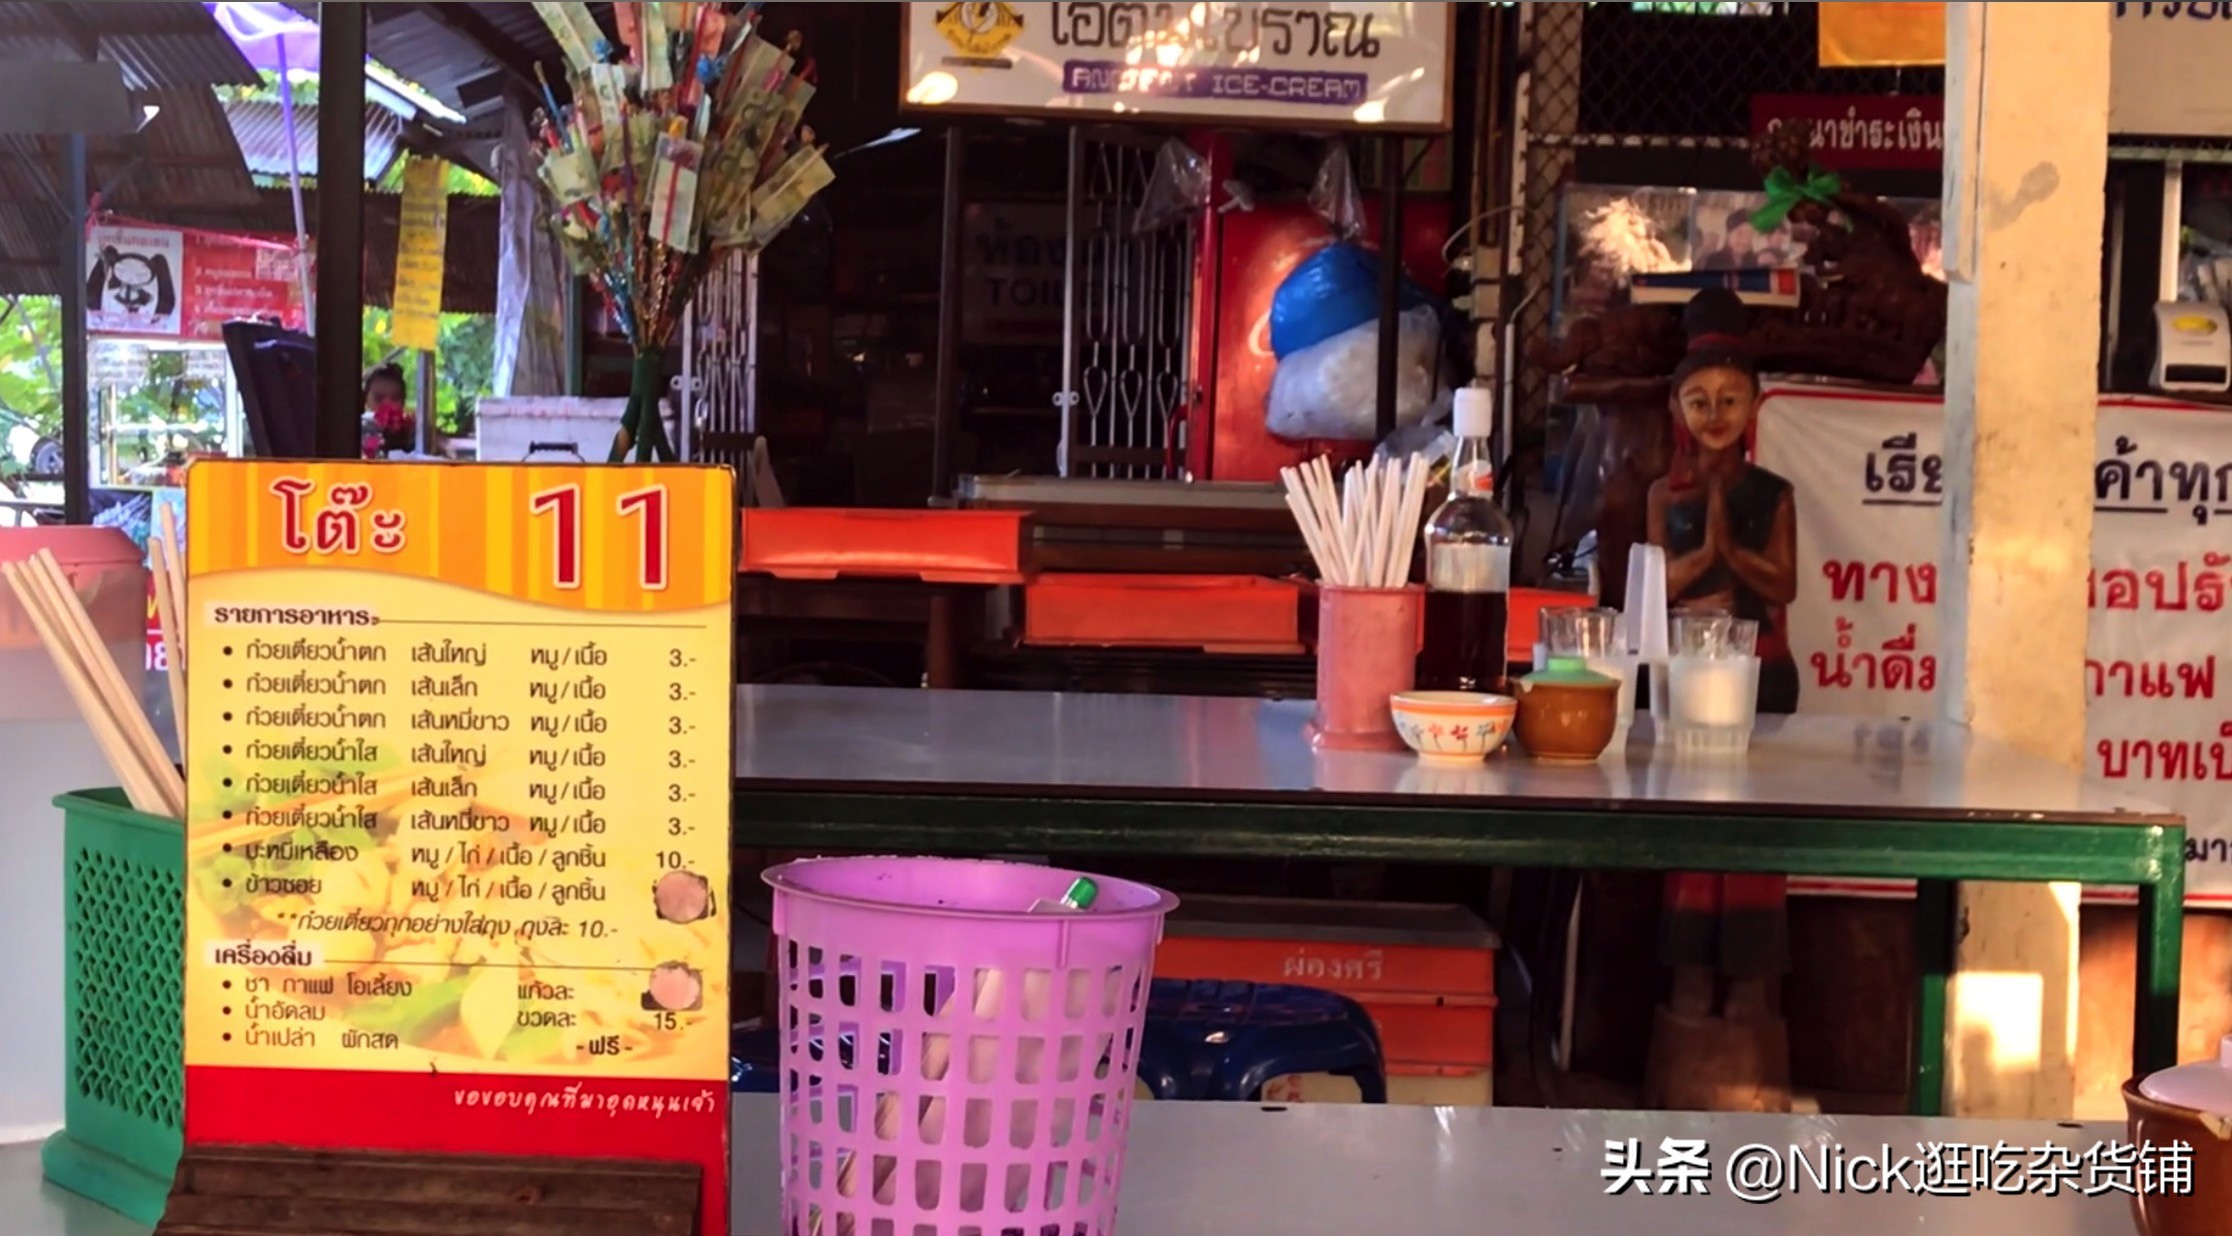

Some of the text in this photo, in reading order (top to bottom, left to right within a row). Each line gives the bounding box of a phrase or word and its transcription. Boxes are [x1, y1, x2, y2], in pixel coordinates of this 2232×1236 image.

[1212, 72, 1362, 98] ICE-CREAM
[271, 476, 669, 591] โต๊ะ 11
[2087, 551, 2232, 613] อปรั
[411, 638, 487, 667] เส้นใหญ่
[668, 648, 697, 668] 3.-
[411, 674, 478, 697] เส้นเล็ก
[668, 681, 697, 702] 3.-
[411, 706, 510, 732] เส้นหมี่ขาว
[668, 715, 697, 736] 3.-
[411, 739, 487, 768] เส้นใหญ่
[668, 749, 697, 769] 3.-
[411, 775, 478, 798] เส้นเล็ก
[668, 783, 697, 803] 3.-
[411, 806, 510, 832] เส้นหมี่ขาว
[668, 817, 697, 836] 3.-
[246, 873, 322, 894] ข้าวซอย
[579, 920, 619, 939] 10.-
[215, 940, 312, 966] เครื่องดื่ม
[246, 977, 270, 992] ชา
[282, 977, 334, 995] กาแฟ
[347, 972, 412, 997] โอเลี้ยง
[246, 996, 693, 1031] น้ำอัดลม ขวดละ 15.-
[246, 1022, 316, 1047] น้ำเปล่า
[341, 1030, 399, 1049] ผักสด
